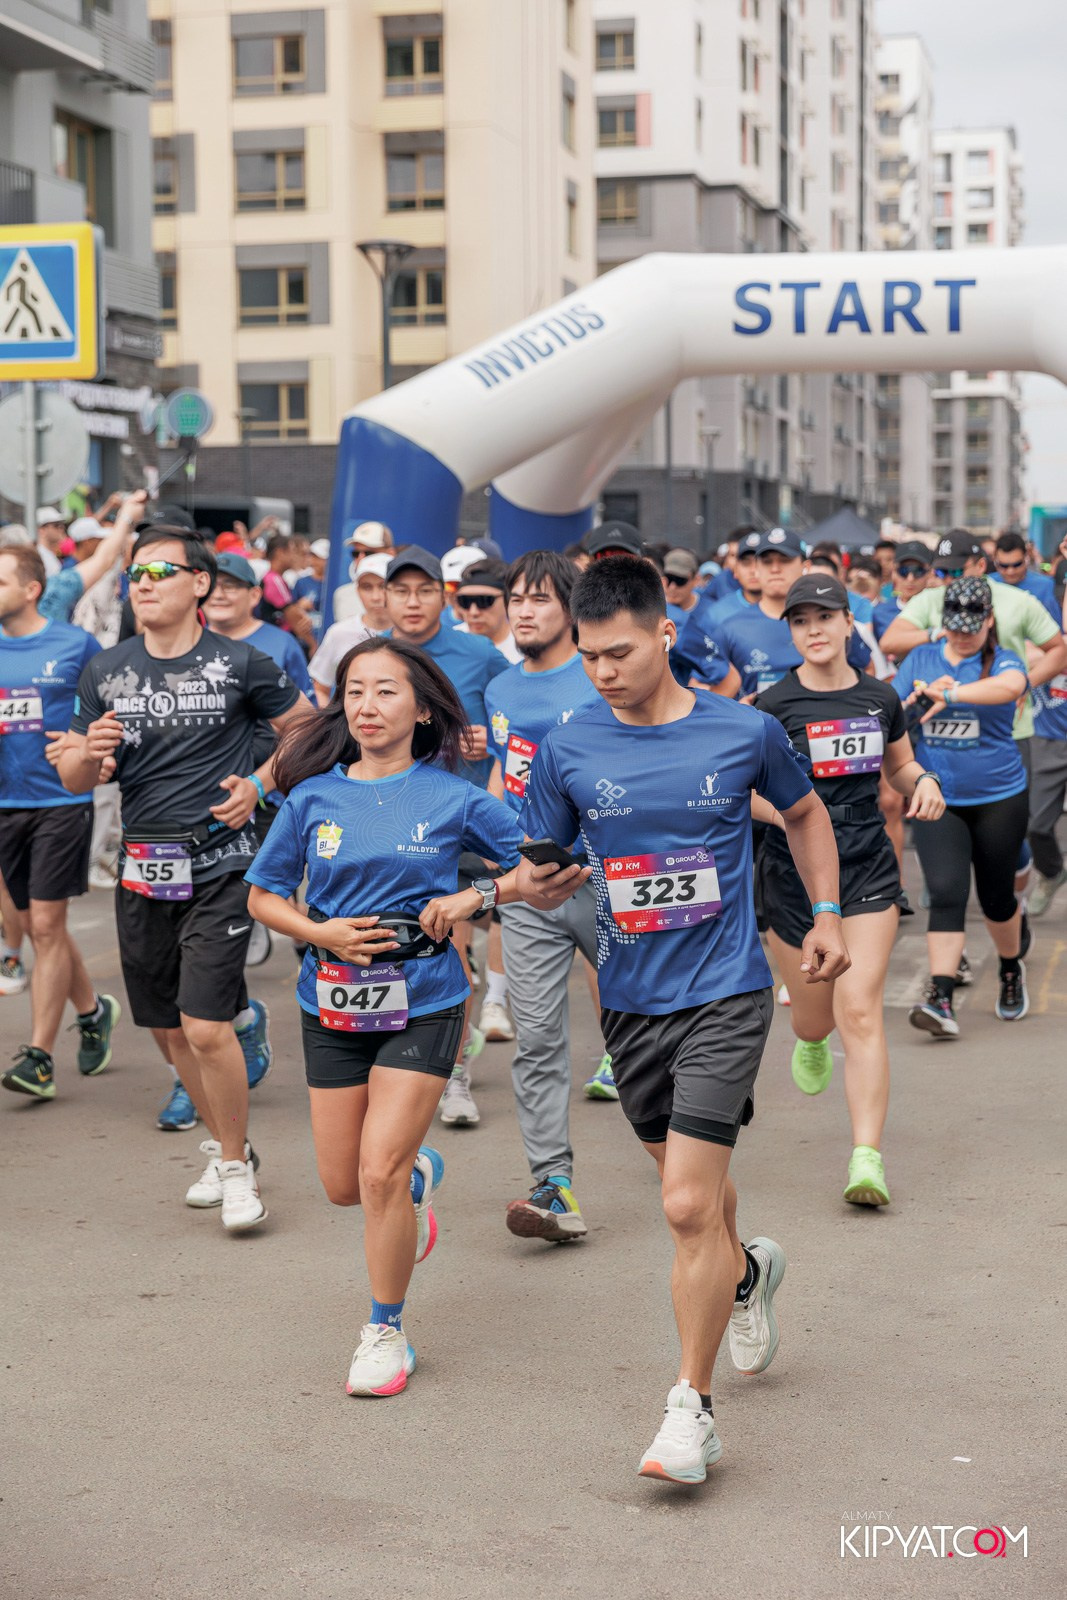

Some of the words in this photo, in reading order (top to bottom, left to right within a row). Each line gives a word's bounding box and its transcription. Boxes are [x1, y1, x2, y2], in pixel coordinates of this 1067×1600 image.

[733, 279, 977, 336] START
[465, 304, 604, 388] INVICTUS
[177, 681, 207, 694] 2023
[0, 702, 29, 717] 44
[113, 697, 146, 713] RACE
[177, 694, 226, 710] NATION
[124, 717, 226, 728] AZAKHSTAN
[929, 722, 971, 735] 1777
[811, 726, 821, 734] 10
[511, 739, 521, 749] 10
[521, 744, 532, 752] KM
[832, 736, 866, 757] 161
[697, 797, 732, 806] JULDYZAI
[599, 807, 632, 818] GROUP
[318, 840, 327, 849] BI
[406, 845, 440, 853] JULDYZAI
[675, 855, 697, 864] GROUP
[610, 861, 622, 872] 10
[626, 861, 640, 870] KM
[631, 873, 697, 907] 323
[329, 969, 339, 977] KM
[369, 968, 389, 976] GROUP
[331, 985, 391, 1010] 047
